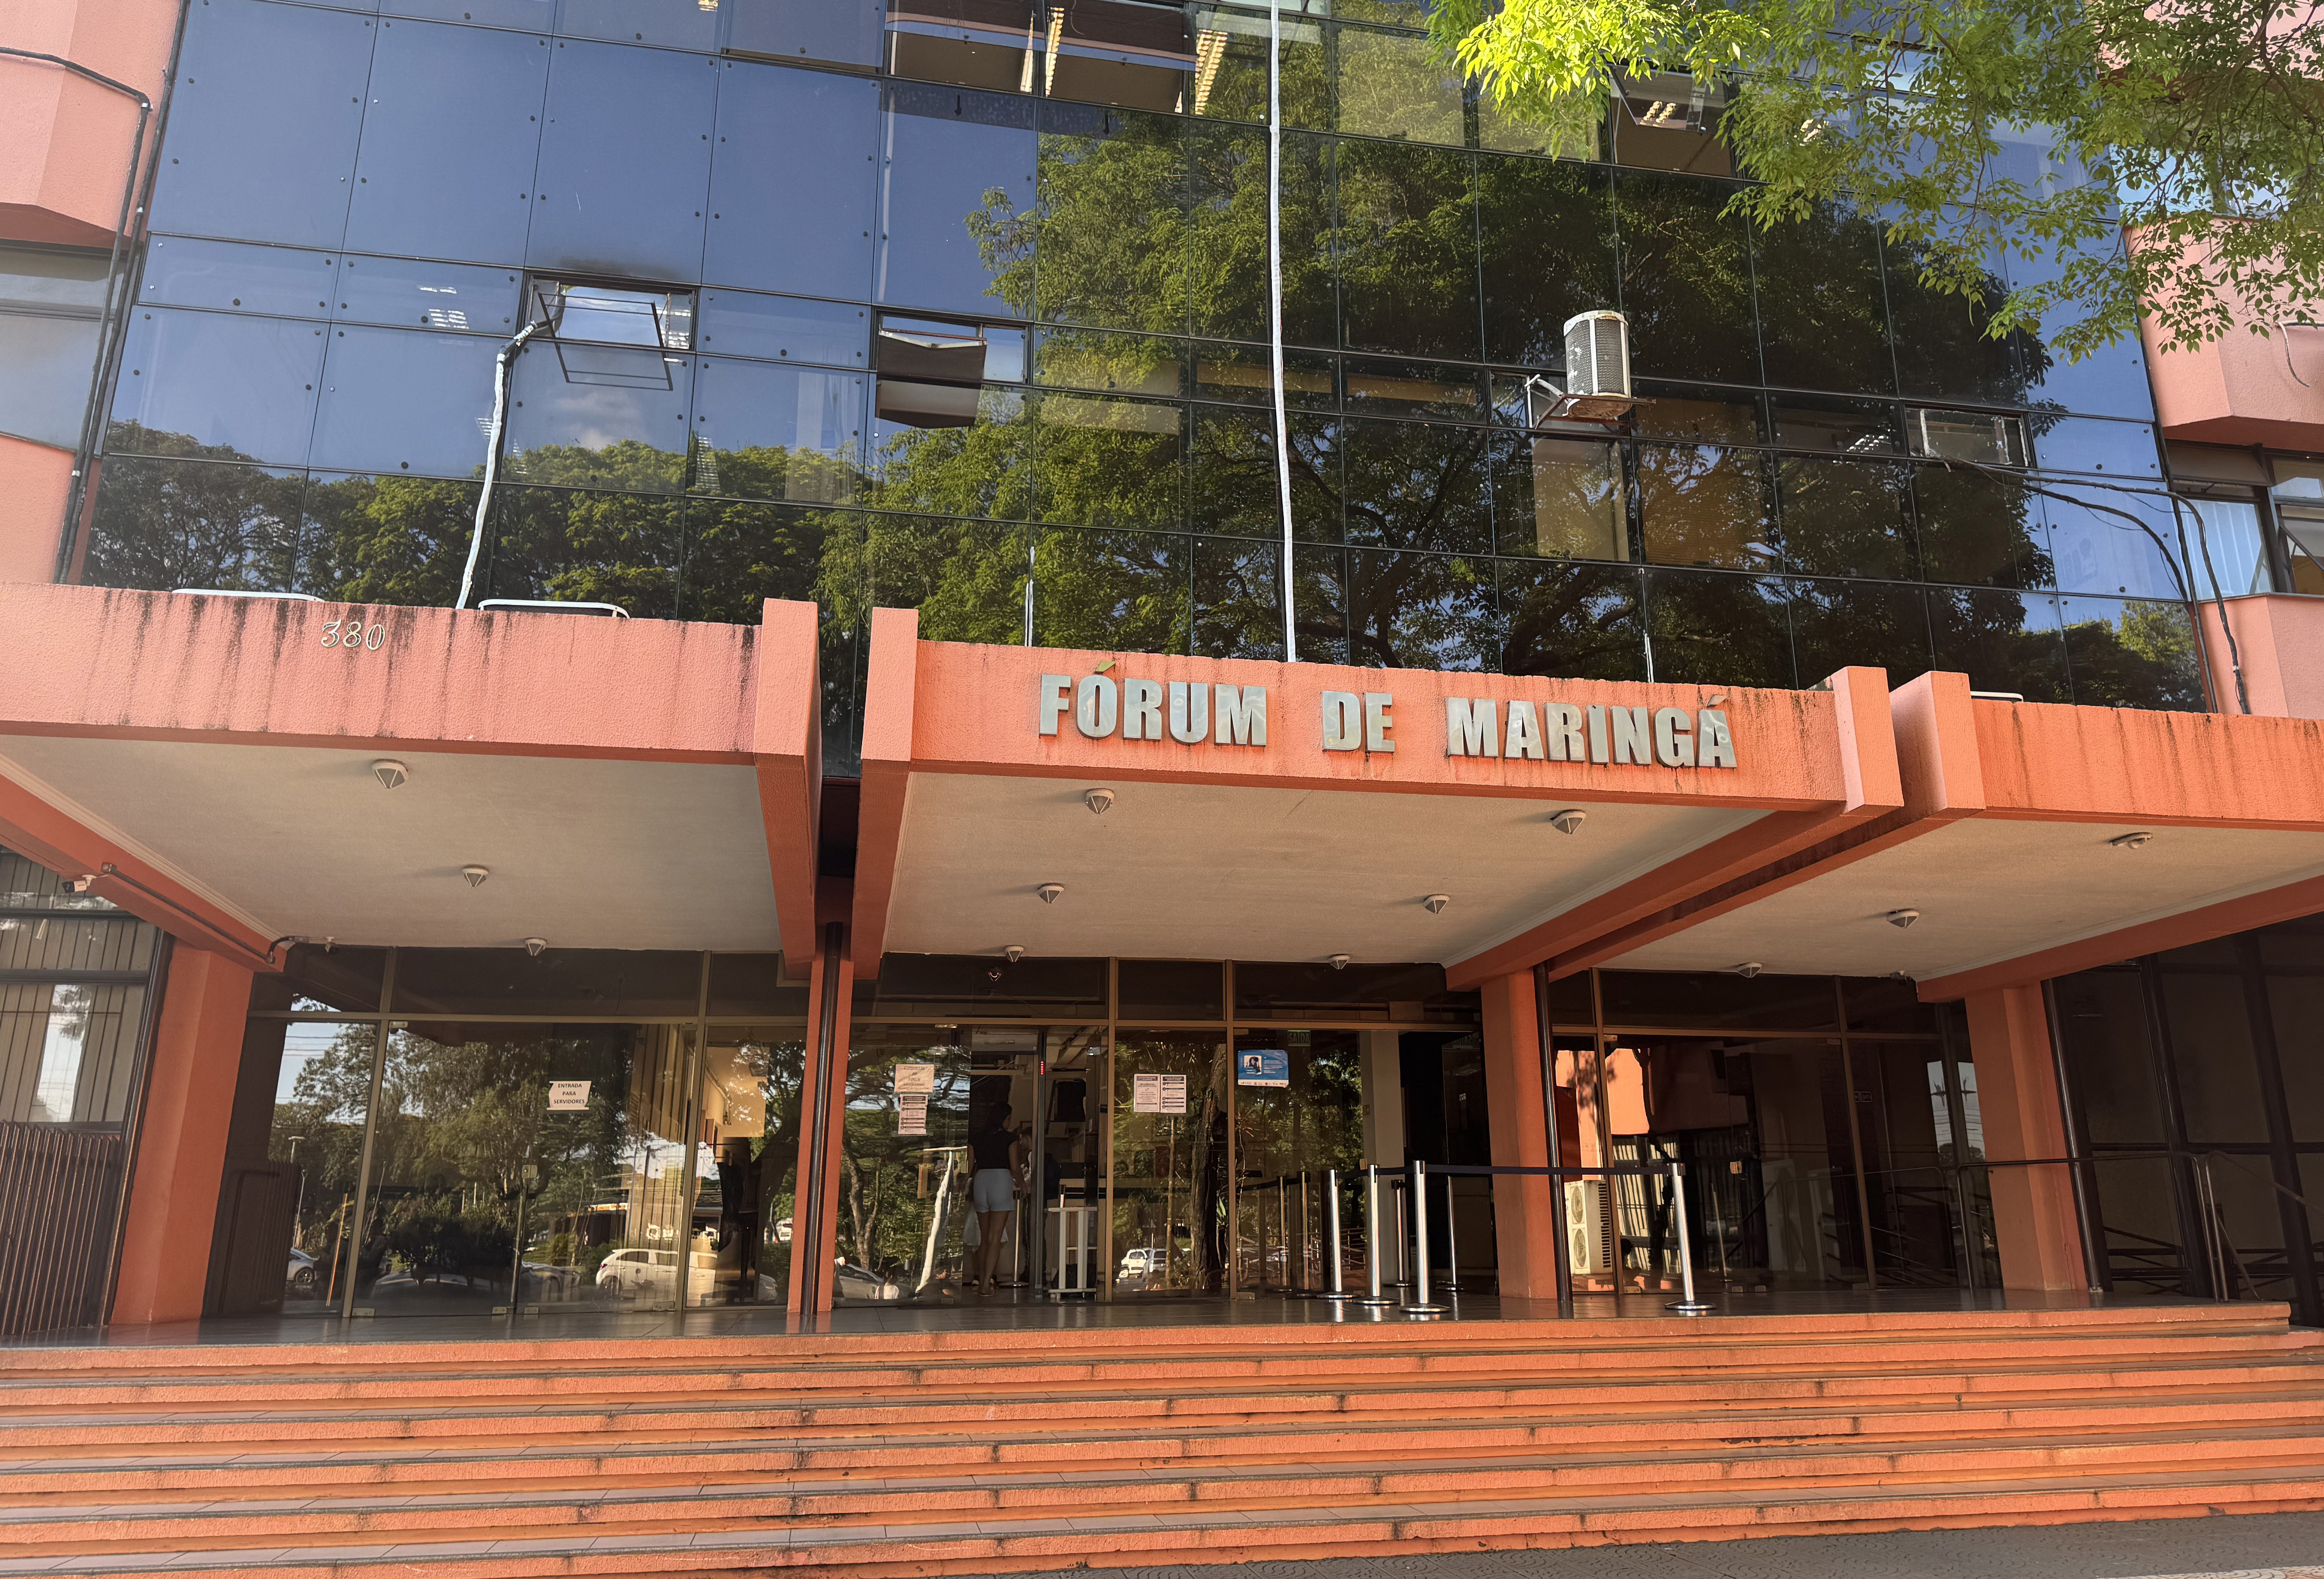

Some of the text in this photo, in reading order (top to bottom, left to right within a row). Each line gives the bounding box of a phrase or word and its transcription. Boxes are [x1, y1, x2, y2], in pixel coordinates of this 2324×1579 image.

[321, 618, 386, 650] 380
[1039, 661, 1737, 769] FÓRUM DE MARINGÁ
